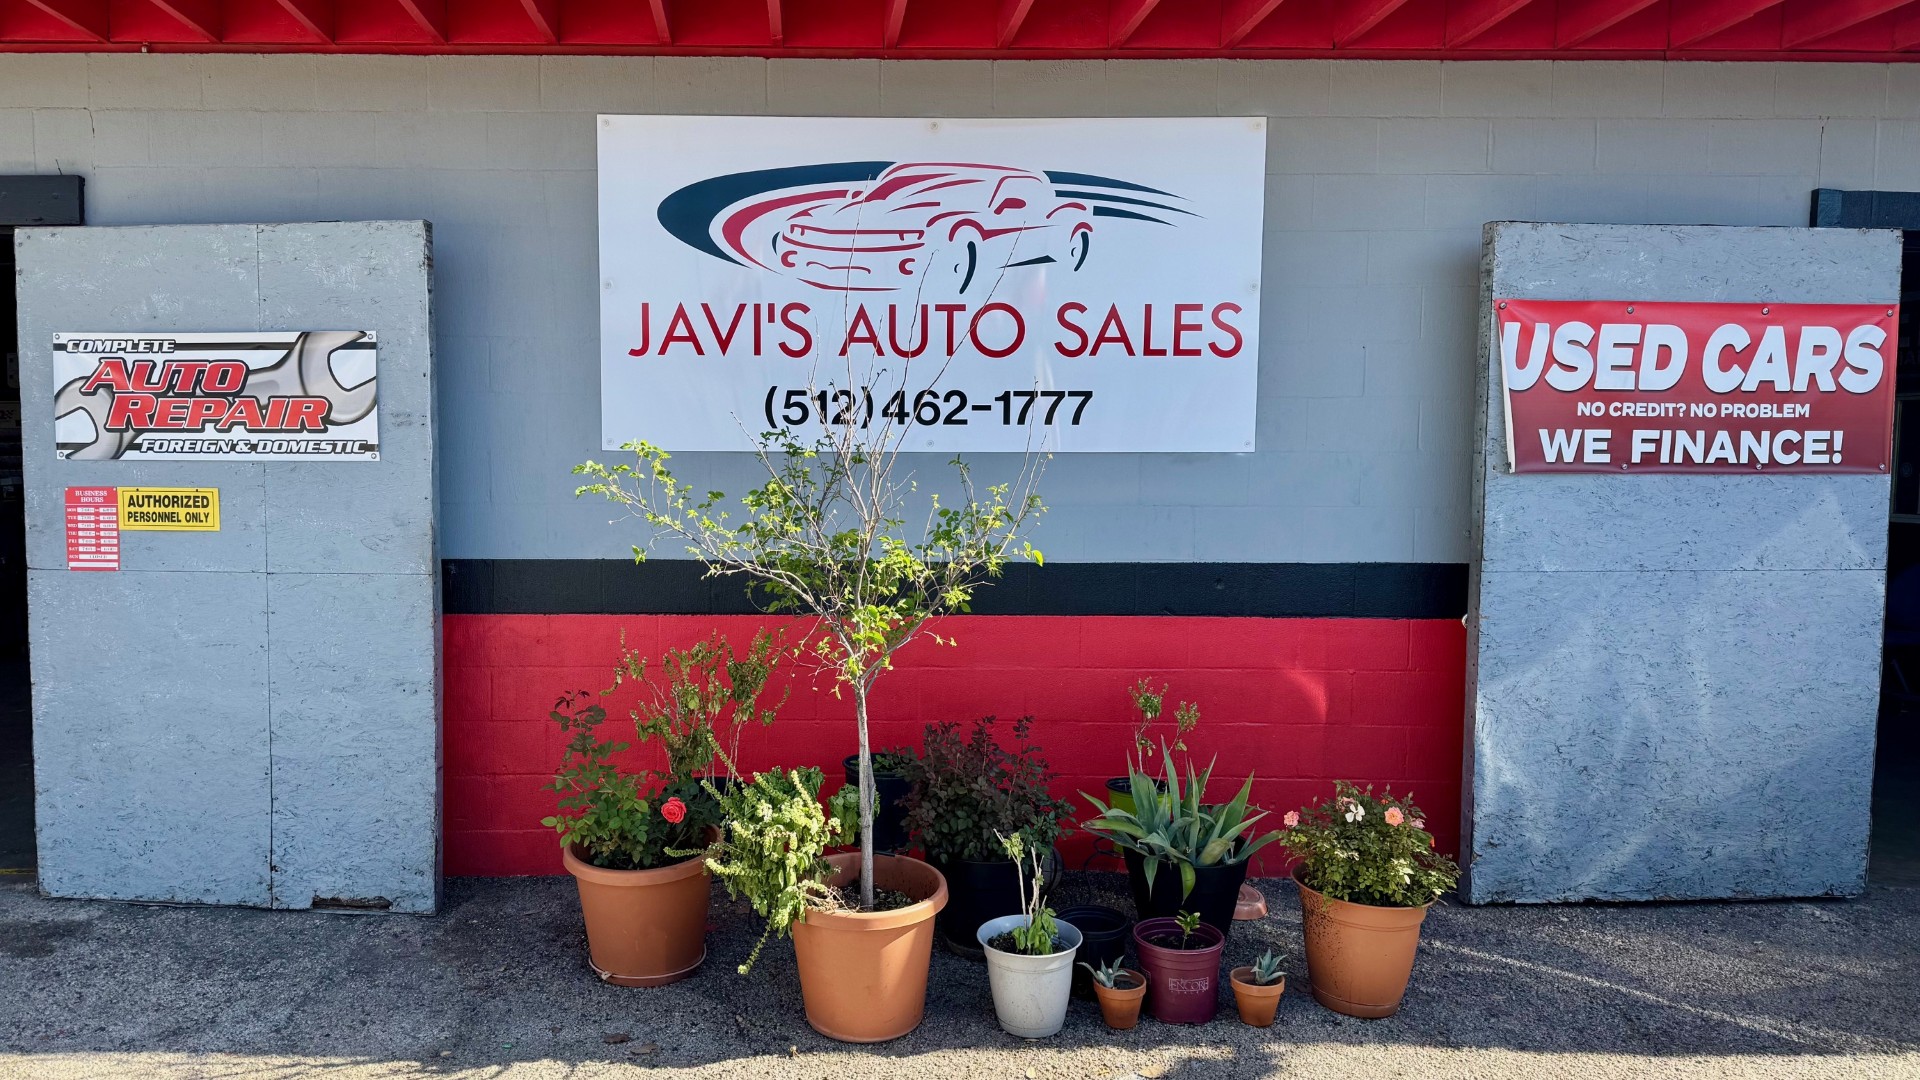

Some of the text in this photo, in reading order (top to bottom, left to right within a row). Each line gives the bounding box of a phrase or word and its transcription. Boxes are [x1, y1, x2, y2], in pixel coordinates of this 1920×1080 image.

[627, 301, 1243, 359] JAVI'S AUTO SALES
[66, 340, 176, 353] COMPLETE
[1502, 320, 1887, 394] USED CARS
[81, 357, 249, 393] AUTO
[105, 393, 329, 430] REPAIR
[1577, 401, 1811, 418] NO CREDIT? NO PROBLEM
[141, 439, 367, 455] FOREIGN & DOMESTIC
[1538, 428, 1844, 465] WE FINANCE!
[127, 494, 210, 509] AUTHORIZED
[127, 511, 182, 523] PERSONNEL
[184, 511, 210, 523] ONLY
